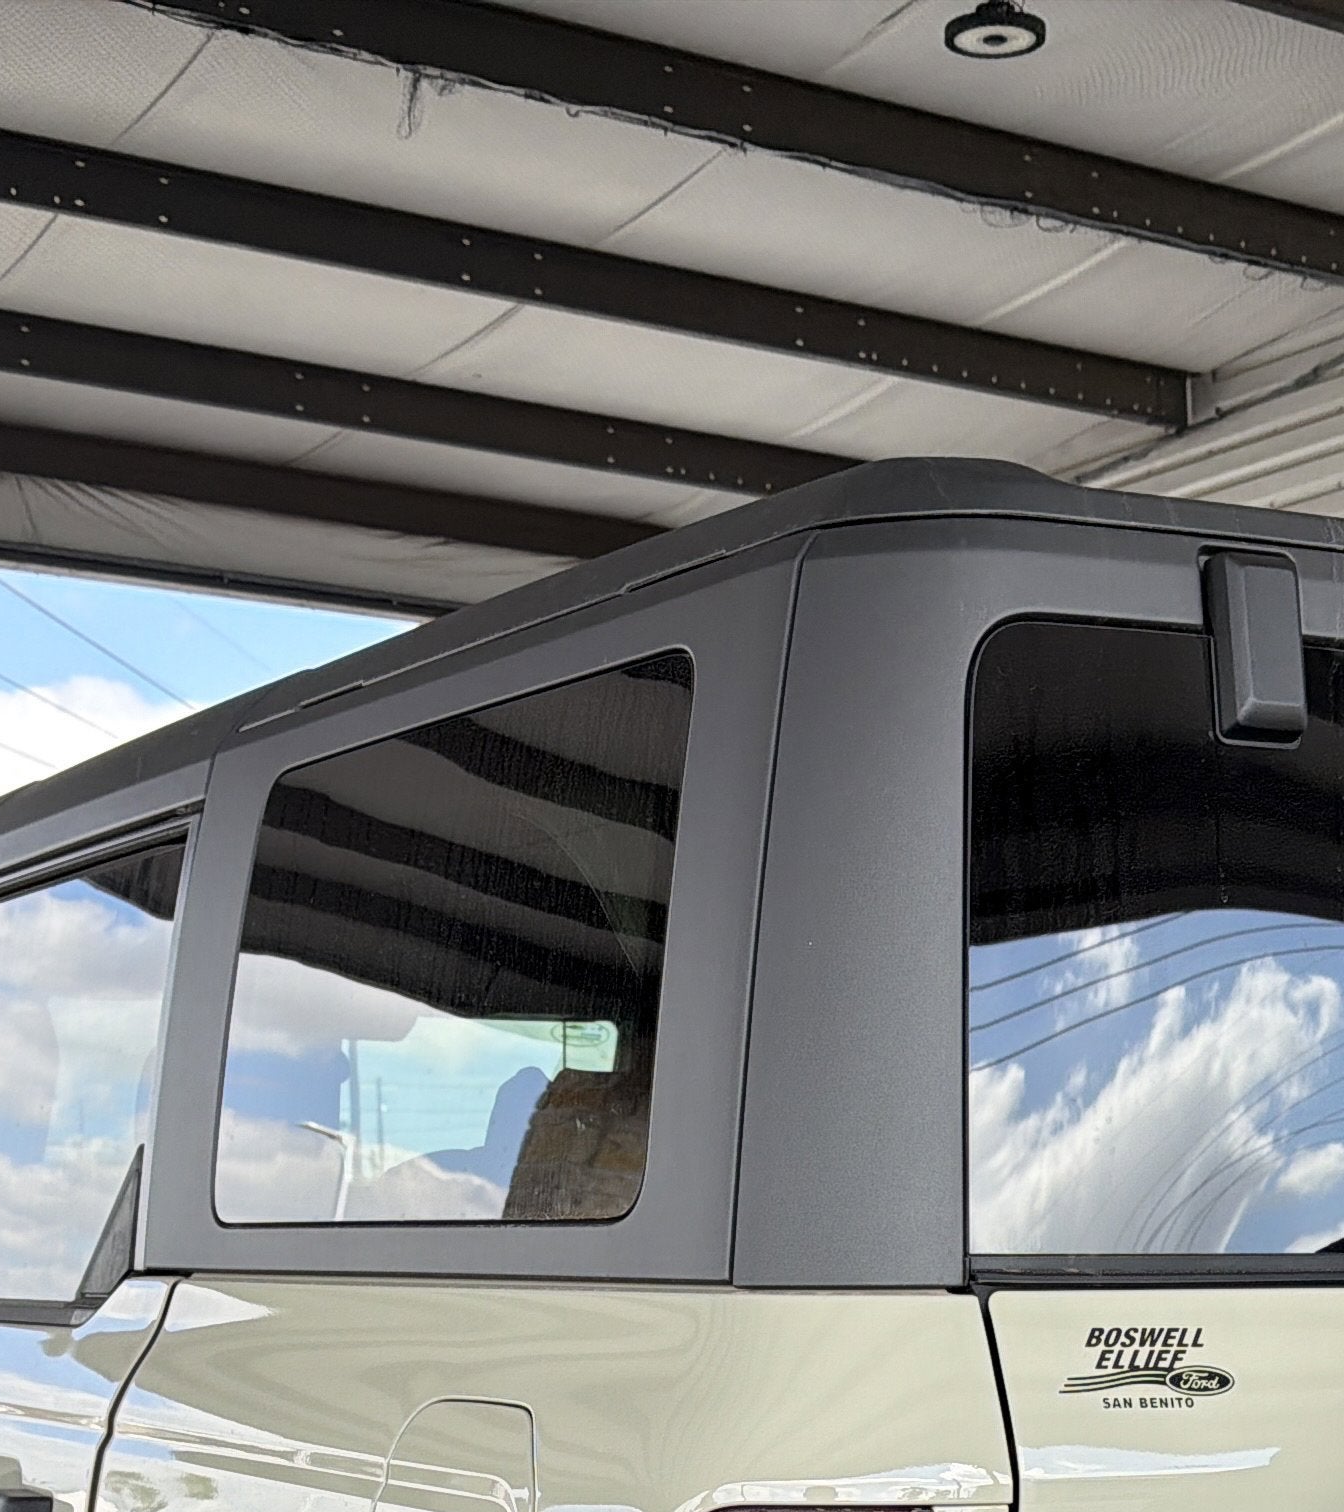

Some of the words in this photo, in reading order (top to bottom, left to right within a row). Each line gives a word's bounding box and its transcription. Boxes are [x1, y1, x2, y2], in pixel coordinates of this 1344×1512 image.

[1084, 1327, 1205, 1348] BOSWELL
[1094, 1349, 1188, 1370] ELLIFF
[1179, 1371, 1221, 1390] Ford
[1102, 1397, 1133, 1409] SAN
[1139, 1397, 1195, 1409] BENITO
